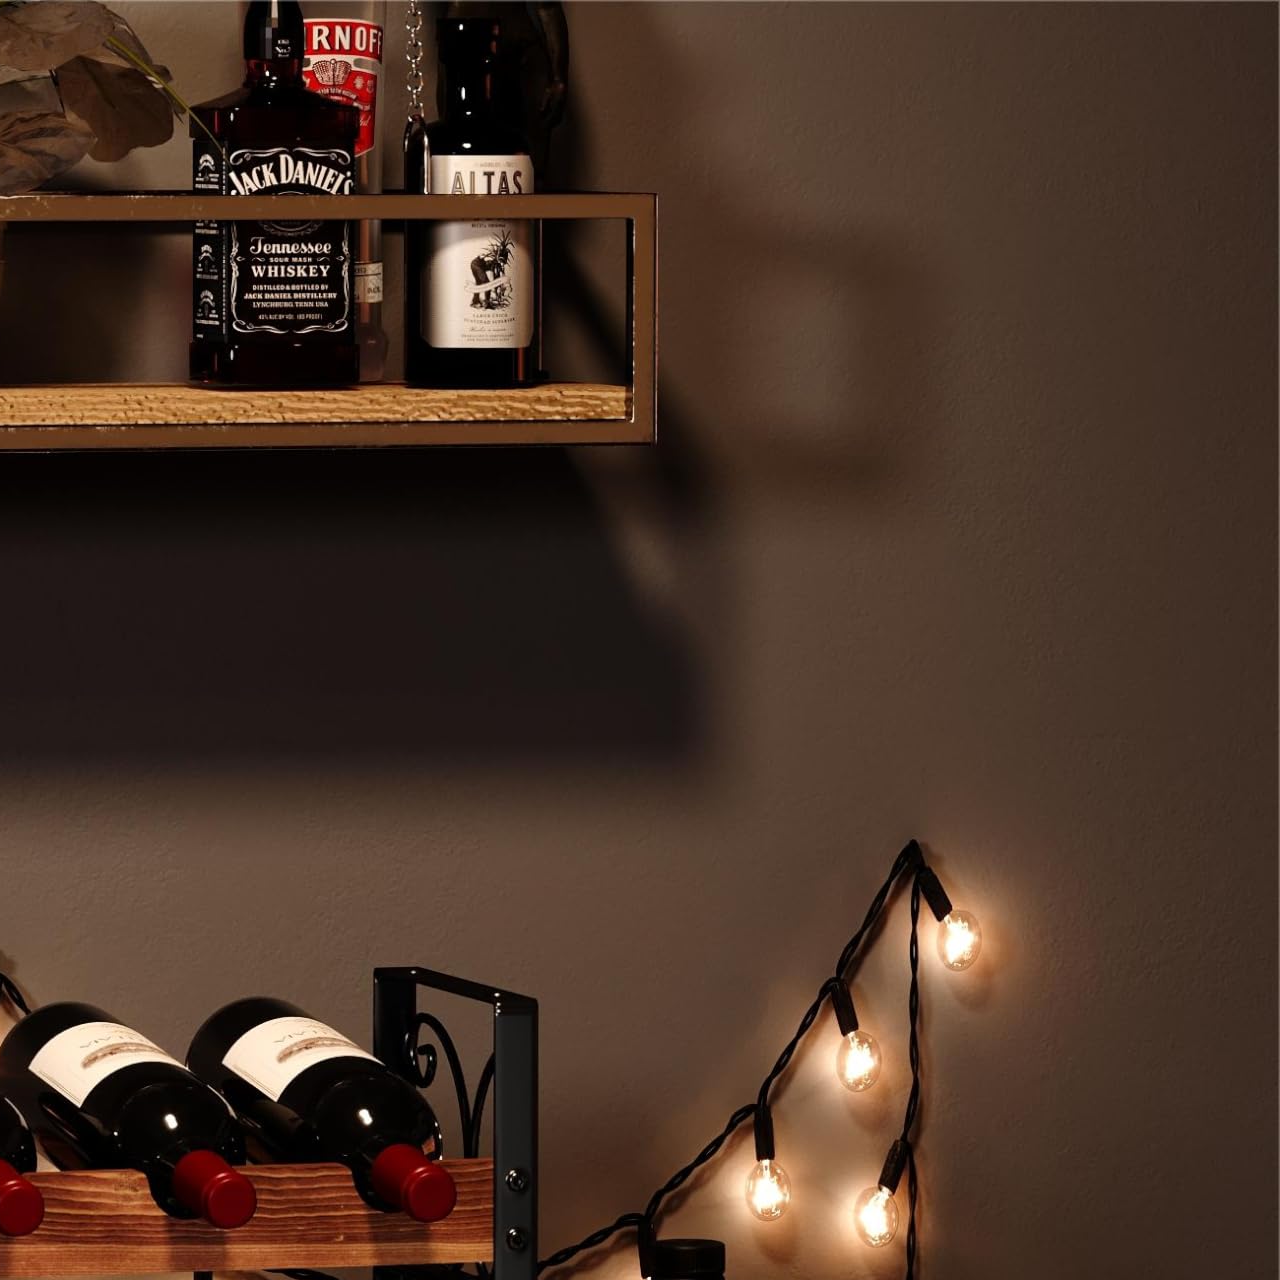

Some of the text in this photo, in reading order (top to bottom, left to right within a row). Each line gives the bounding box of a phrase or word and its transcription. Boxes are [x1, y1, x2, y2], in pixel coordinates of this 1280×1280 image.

[229, 162, 278, 195] JACK
[249, 237, 332, 254] Tennessee
[251, 265, 331, 278] WHISKEY
[244, 292, 263, 300] JACK
[264, 292, 293, 300] DANIEL
